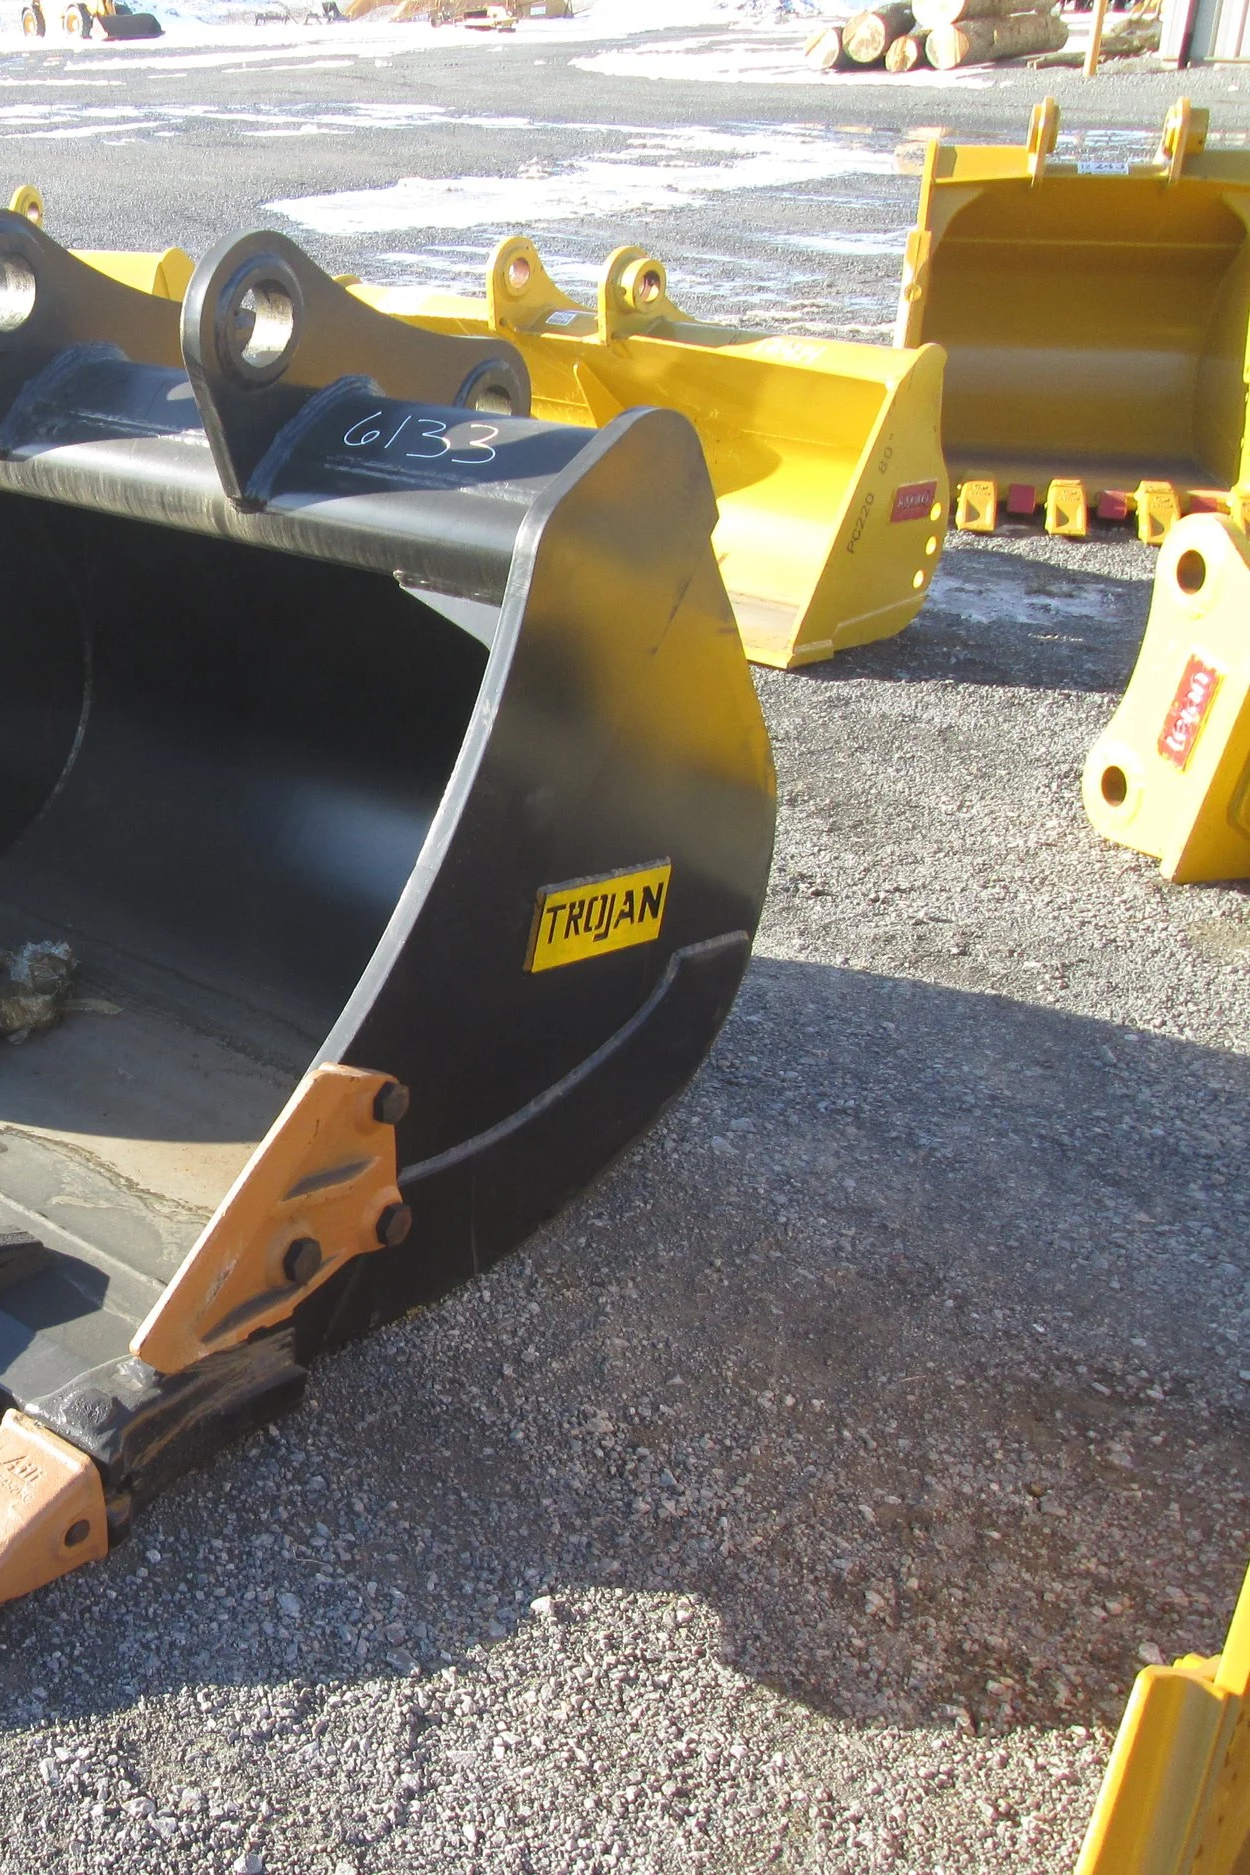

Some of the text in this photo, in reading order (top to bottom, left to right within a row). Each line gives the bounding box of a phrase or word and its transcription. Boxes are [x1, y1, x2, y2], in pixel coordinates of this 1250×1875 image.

[343, 411, 499, 464] 6133
[846, 493, 875, 554] PC220
[546, 882, 664, 943] TROJAN
